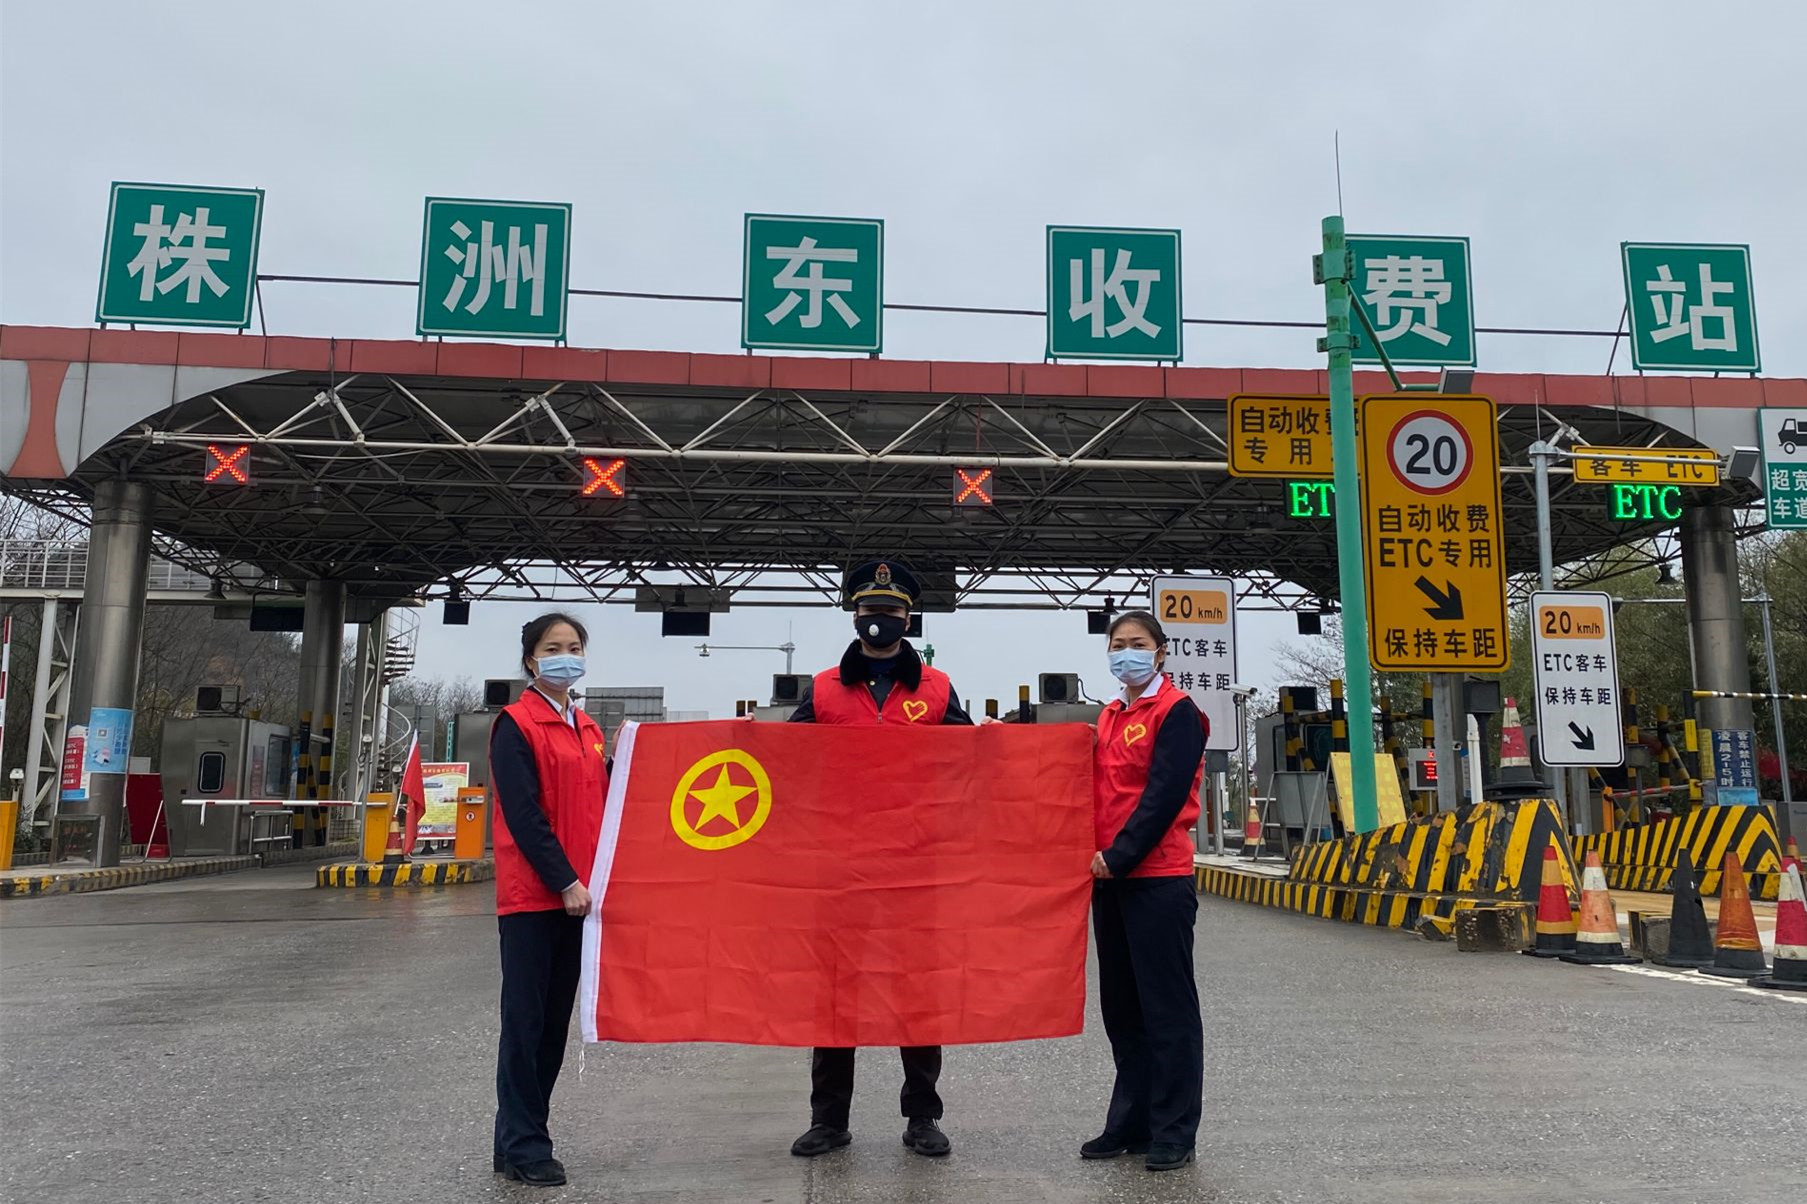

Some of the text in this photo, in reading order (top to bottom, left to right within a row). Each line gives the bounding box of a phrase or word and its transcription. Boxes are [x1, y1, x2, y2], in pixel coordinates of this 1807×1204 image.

[126, 203, 1739, 354] 株洲东收费站
[1244, 437, 1312, 465] 专用
[1405, 433, 1458, 476] 20
[1590, 453, 1704, 479] 客车 ETC
[1771, 468, 1807, 491] 超宽
[1613, 484, 1683, 520] ETC
[1773, 496, 1807, 519] 车道
[1378, 503, 1491, 533] 自动收费
[1379, 537, 1493, 569] ETC专用
[1165, 594, 1223, 620] 20 km/h
[1545, 610, 1601, 635] 20 km/h
[1384, 627, 1498, 659] 保持车距
[1543, 653, 1608, 673] ETC客车
[1545, 686, 1612, 706] 保持车距
[1737, 730, 1753, 788] 客车禁止运行
